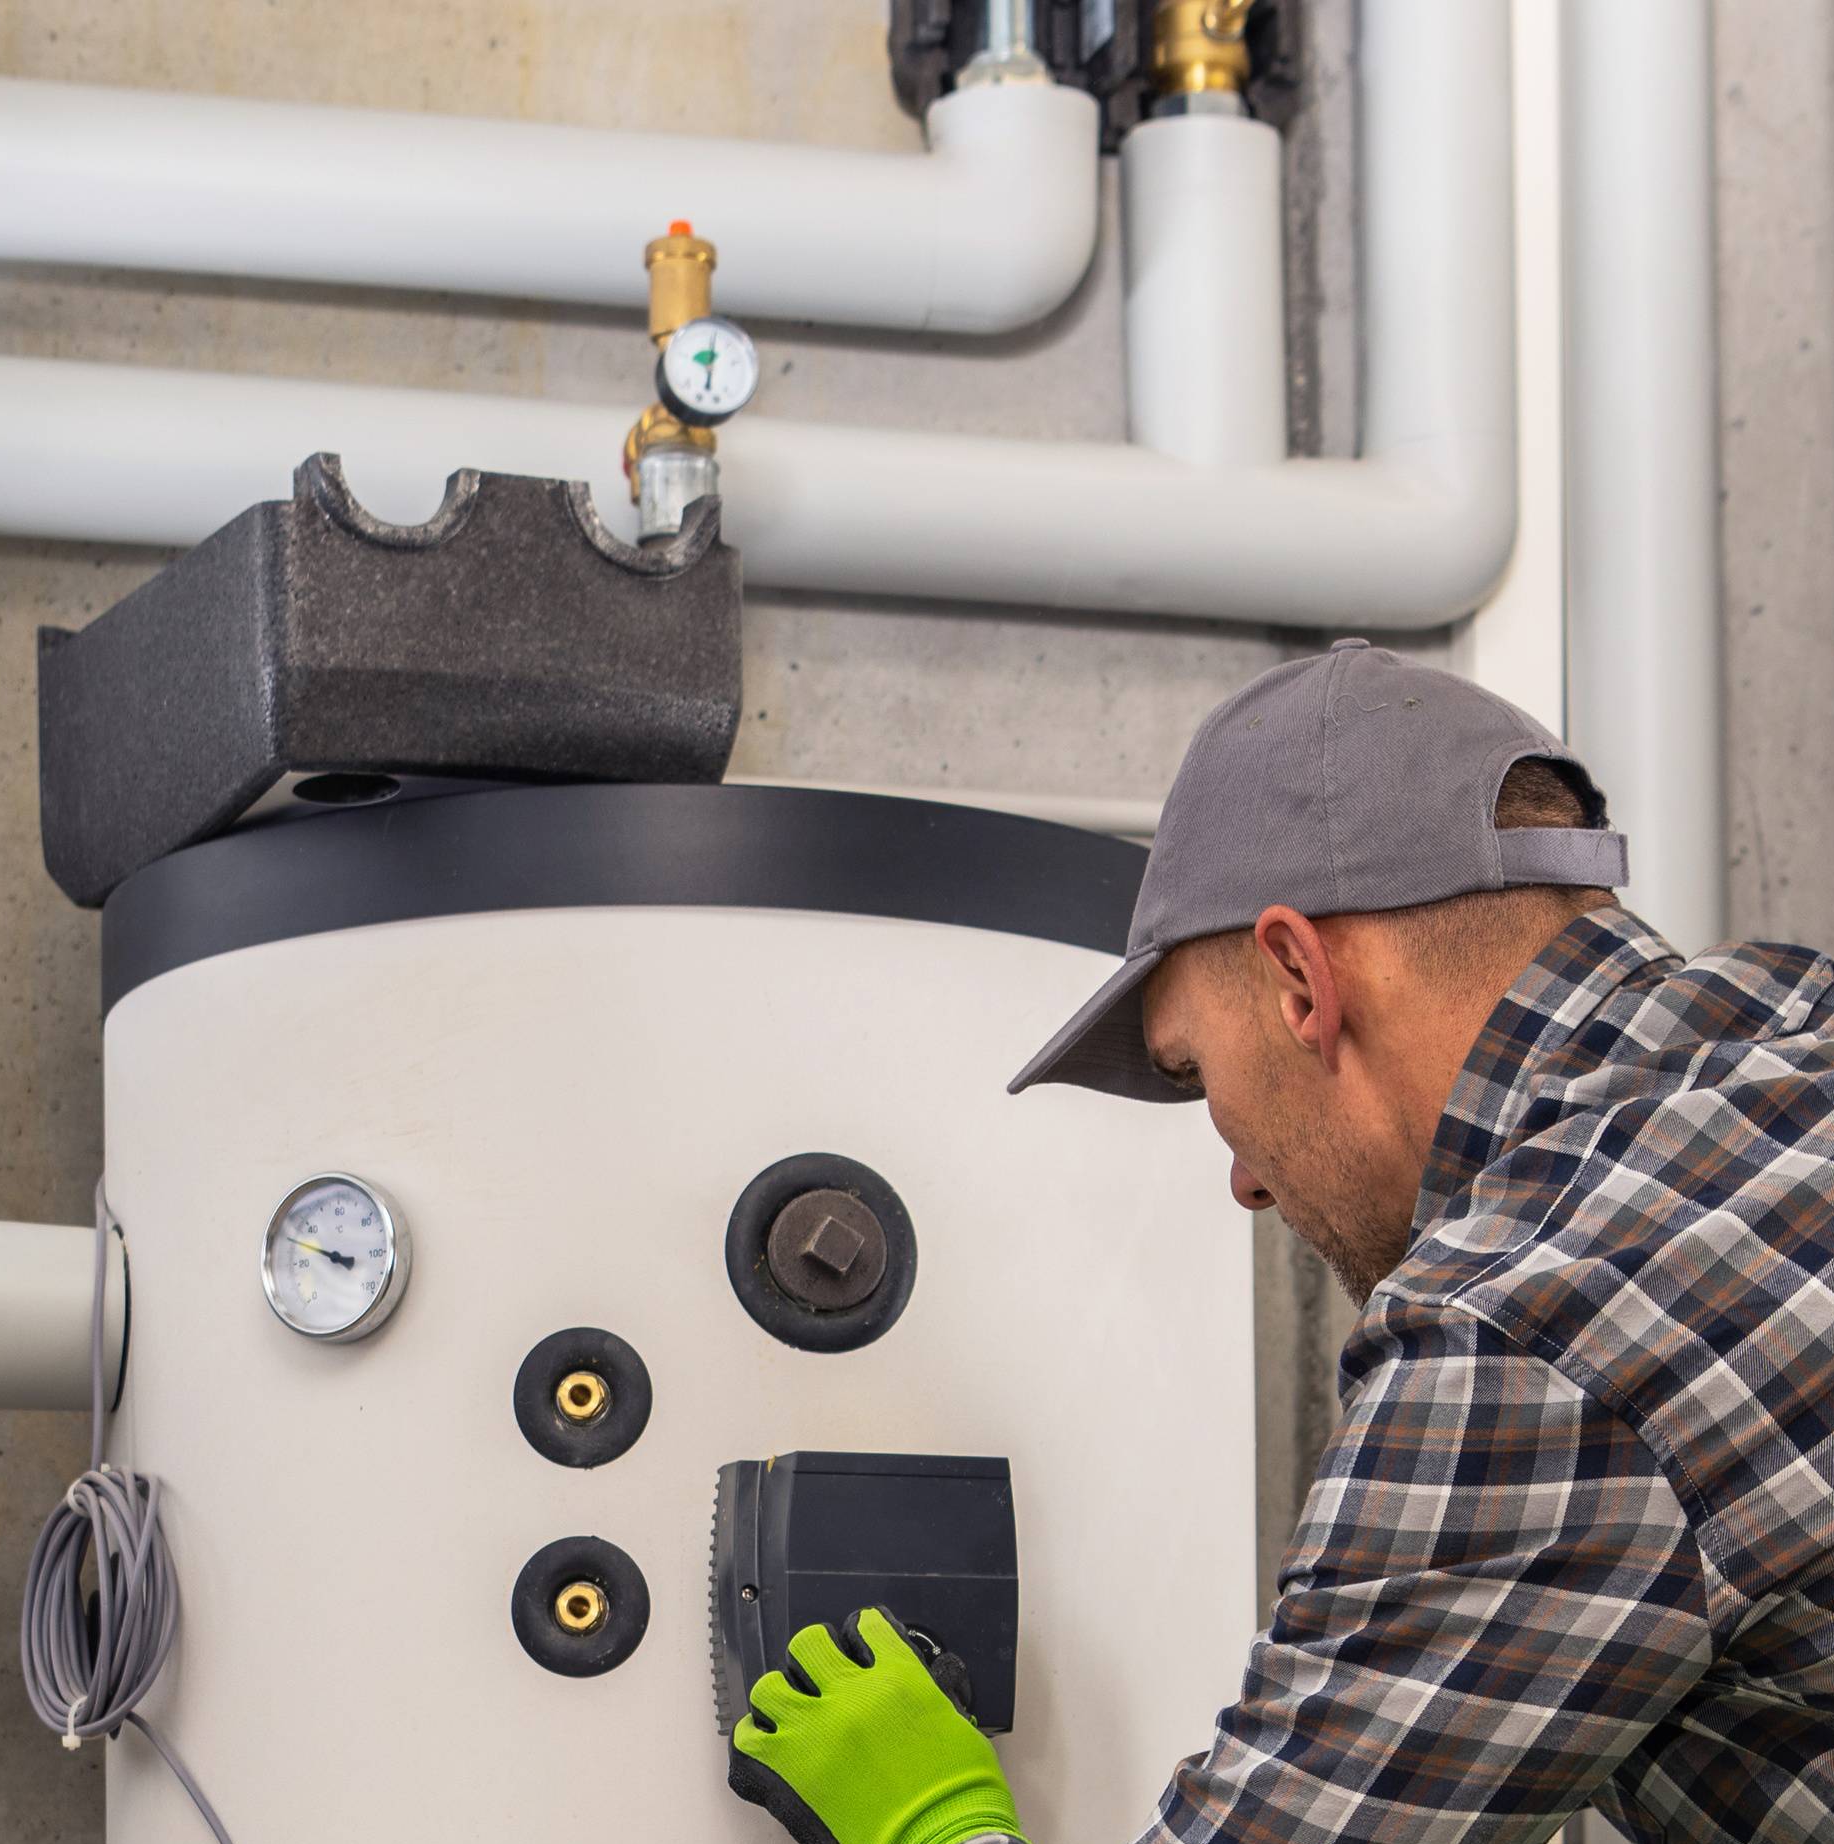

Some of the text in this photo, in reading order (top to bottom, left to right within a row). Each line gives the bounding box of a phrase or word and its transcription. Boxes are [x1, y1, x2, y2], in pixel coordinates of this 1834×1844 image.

[335, 1207, 344, 1216] 60
[308, 1225, 319, 1234] 40
[369, 1248, 384, 1258] 100
[299, 1260, 310, 1268] 20
